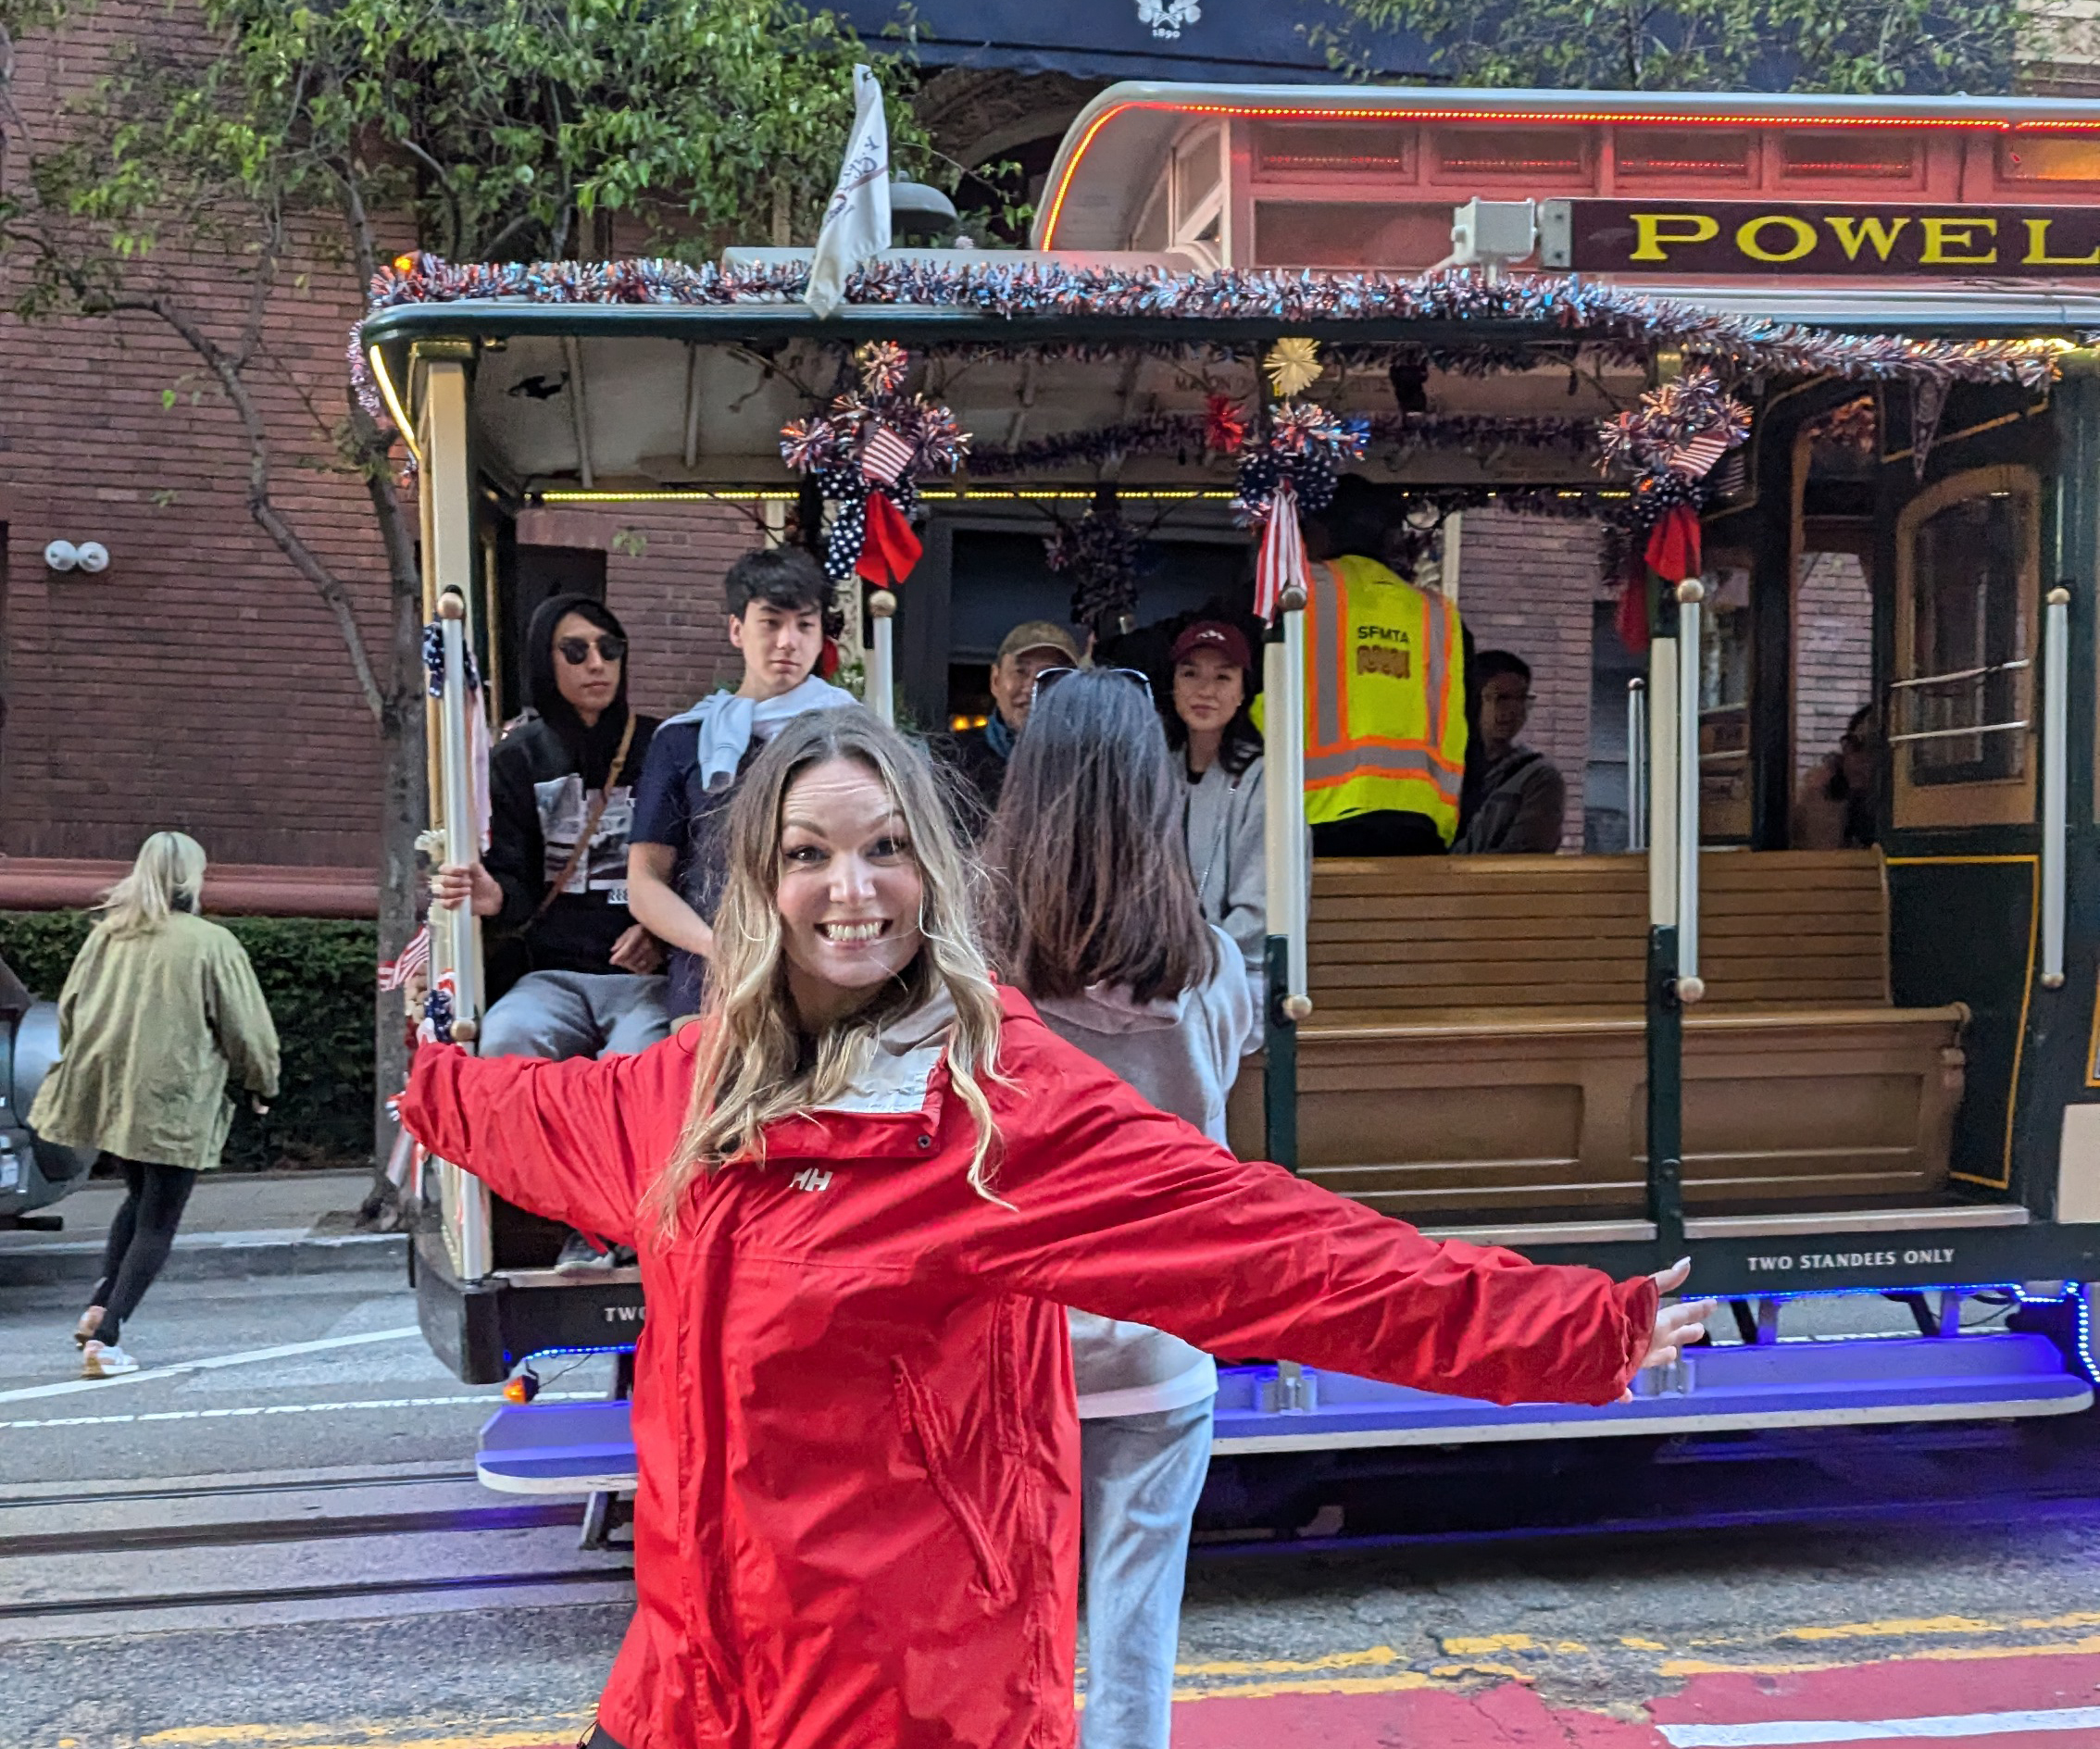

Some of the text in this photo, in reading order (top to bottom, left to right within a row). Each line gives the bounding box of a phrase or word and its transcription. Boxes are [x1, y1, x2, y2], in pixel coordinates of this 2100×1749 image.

[1152, 28, 1181, 39] 1890
[1630, 214, 2100, 265] POWEL
[1357, 625, 1410, 643] SFMTA
[789, 1168, 832, 1192] HH
[1747, 1248, 1955, 1271] TWO STANDEES ONLY
